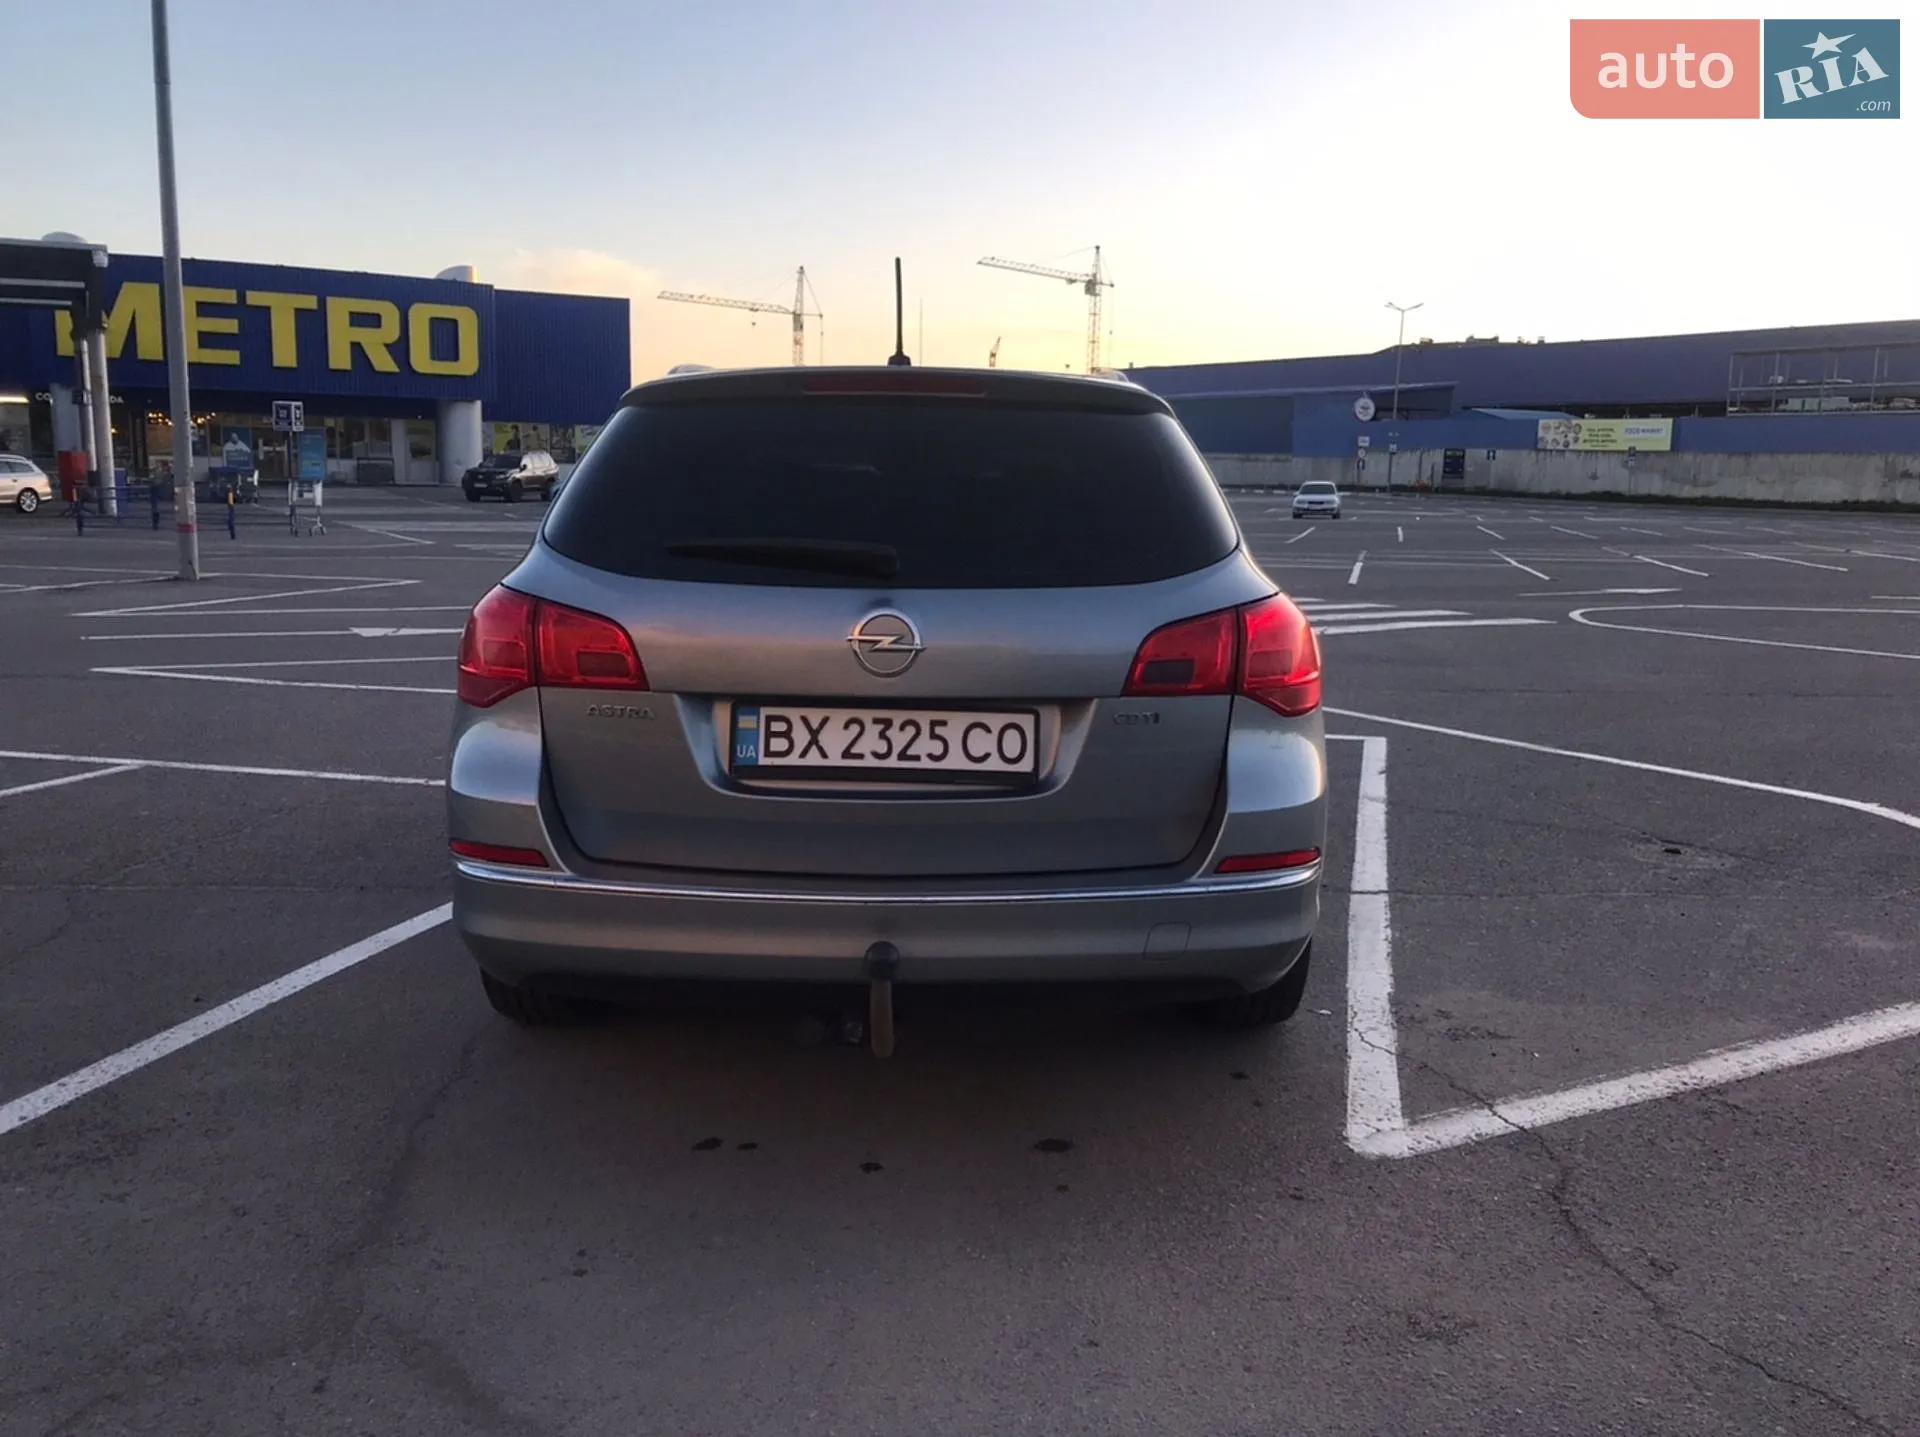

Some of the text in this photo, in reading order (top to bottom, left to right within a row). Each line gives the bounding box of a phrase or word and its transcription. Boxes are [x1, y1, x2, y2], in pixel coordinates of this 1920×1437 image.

[54, 281, 479, 377] METRO
[586, 704, 656, 720] ASTRA
[736, 744, 756, 759] UA
[763, 714, 1028, 765] BX 2325 CO
